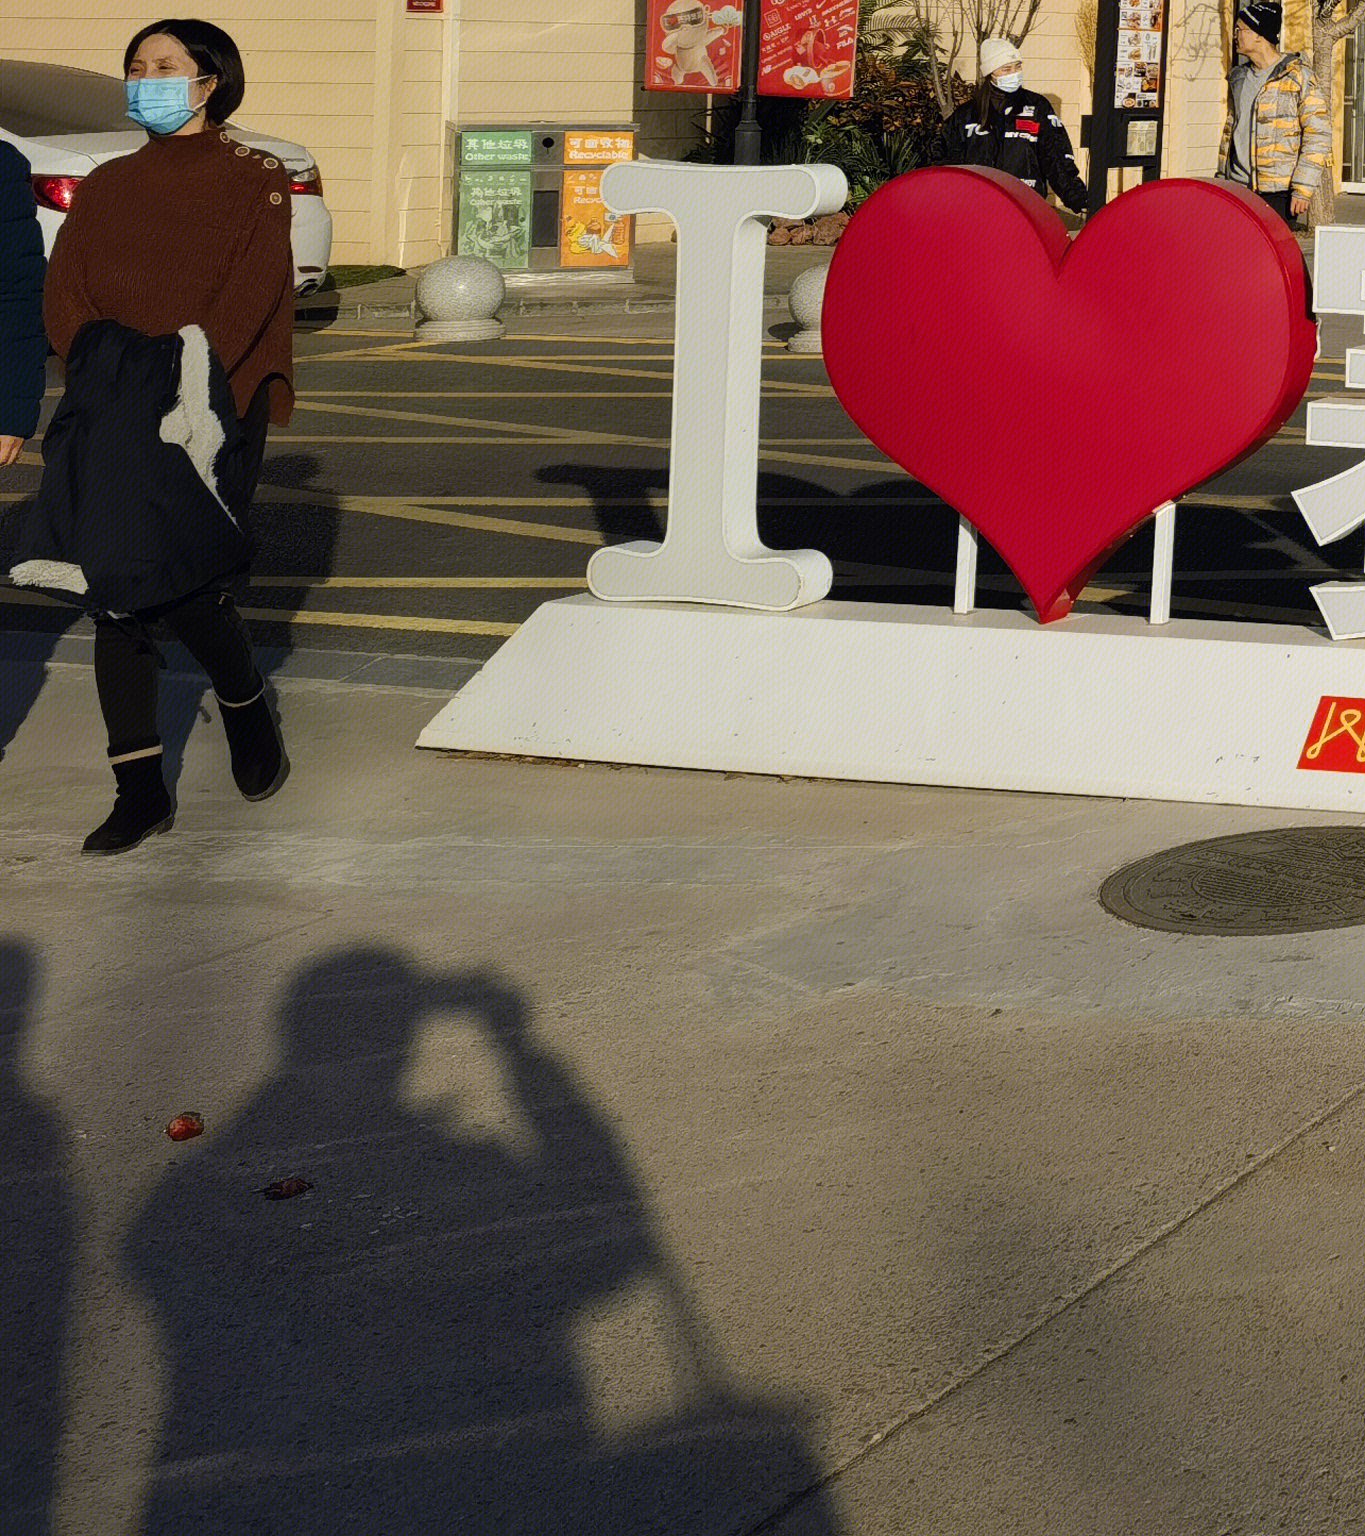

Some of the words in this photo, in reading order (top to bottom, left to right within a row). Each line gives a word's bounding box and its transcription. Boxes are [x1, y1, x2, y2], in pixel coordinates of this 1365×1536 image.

[465, 137, 529, 150] 其他垃圾
[465, 153, 496, 161] Other
[497, 153, 531, 161] waste
